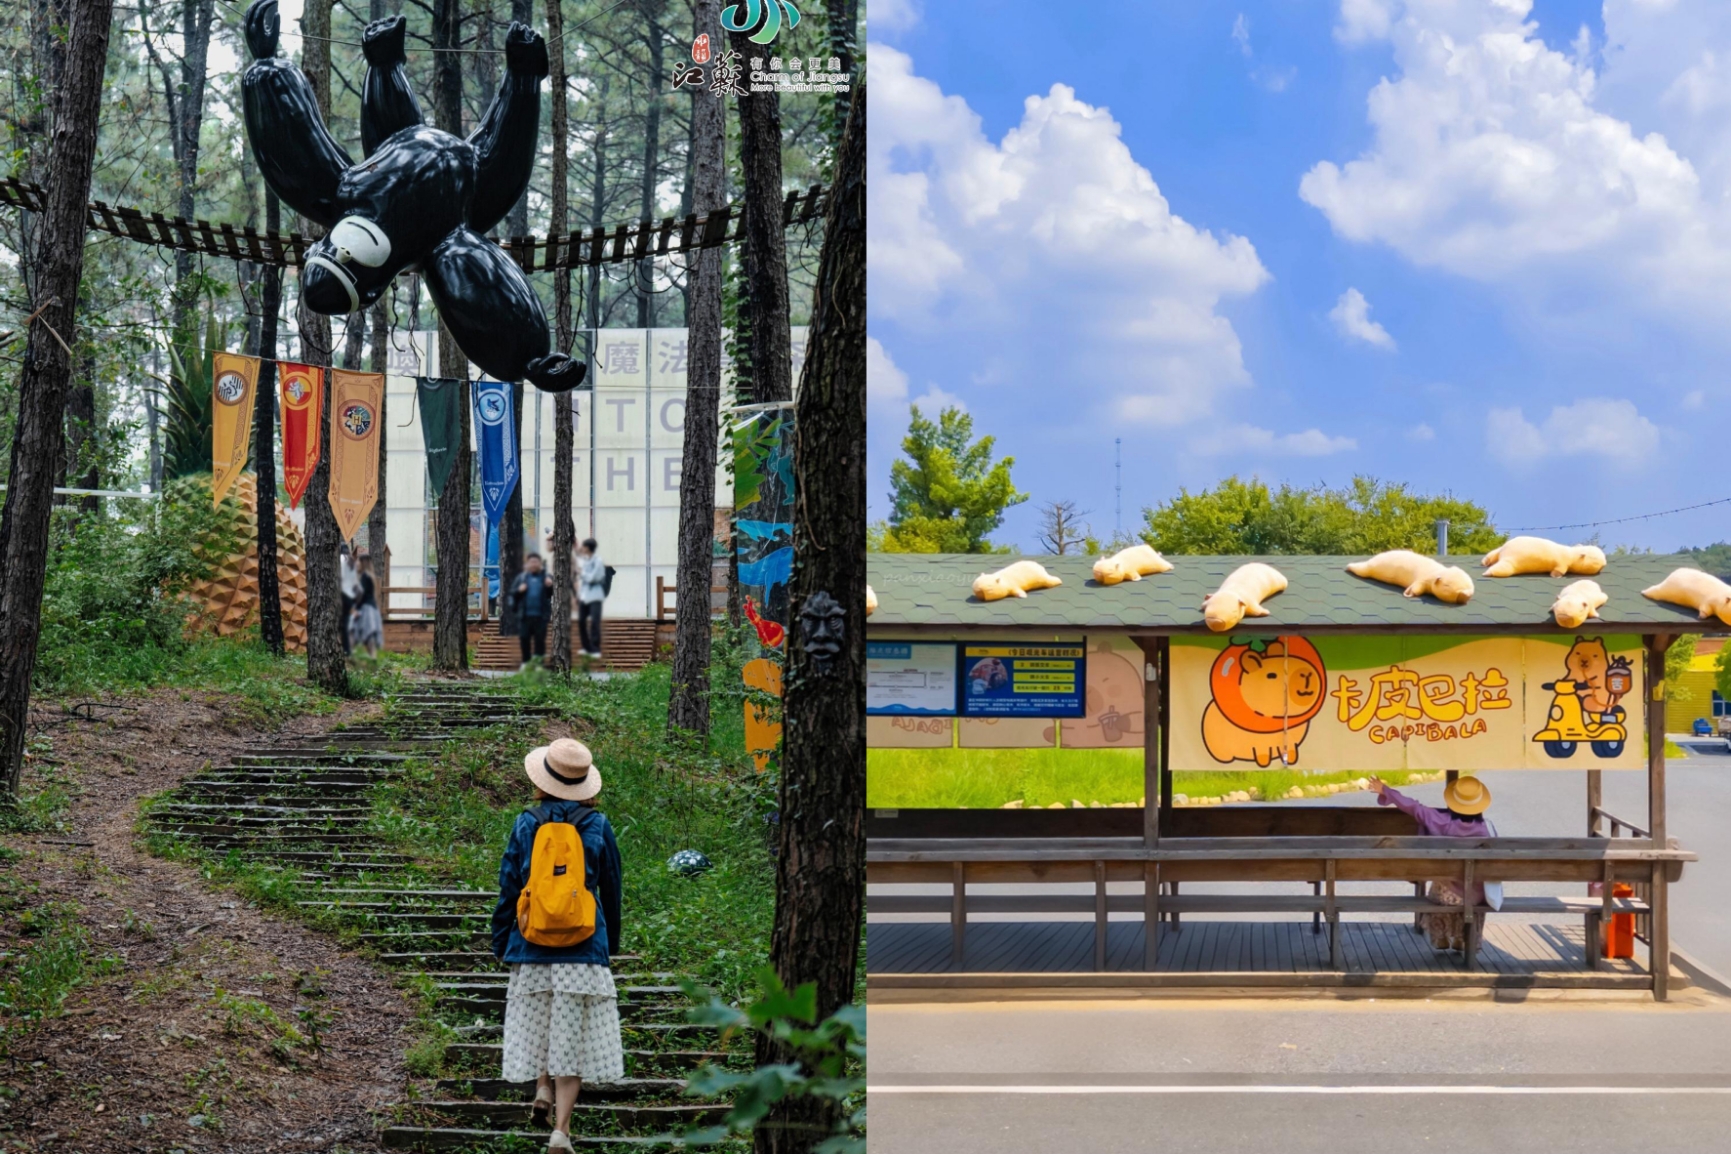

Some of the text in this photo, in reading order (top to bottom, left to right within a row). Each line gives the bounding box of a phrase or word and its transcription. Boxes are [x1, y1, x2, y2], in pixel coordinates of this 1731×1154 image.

[1330, 664, 1512, 732] 卡皮巴拉
[1369, 718, 1487, 745] CAPIBALA
